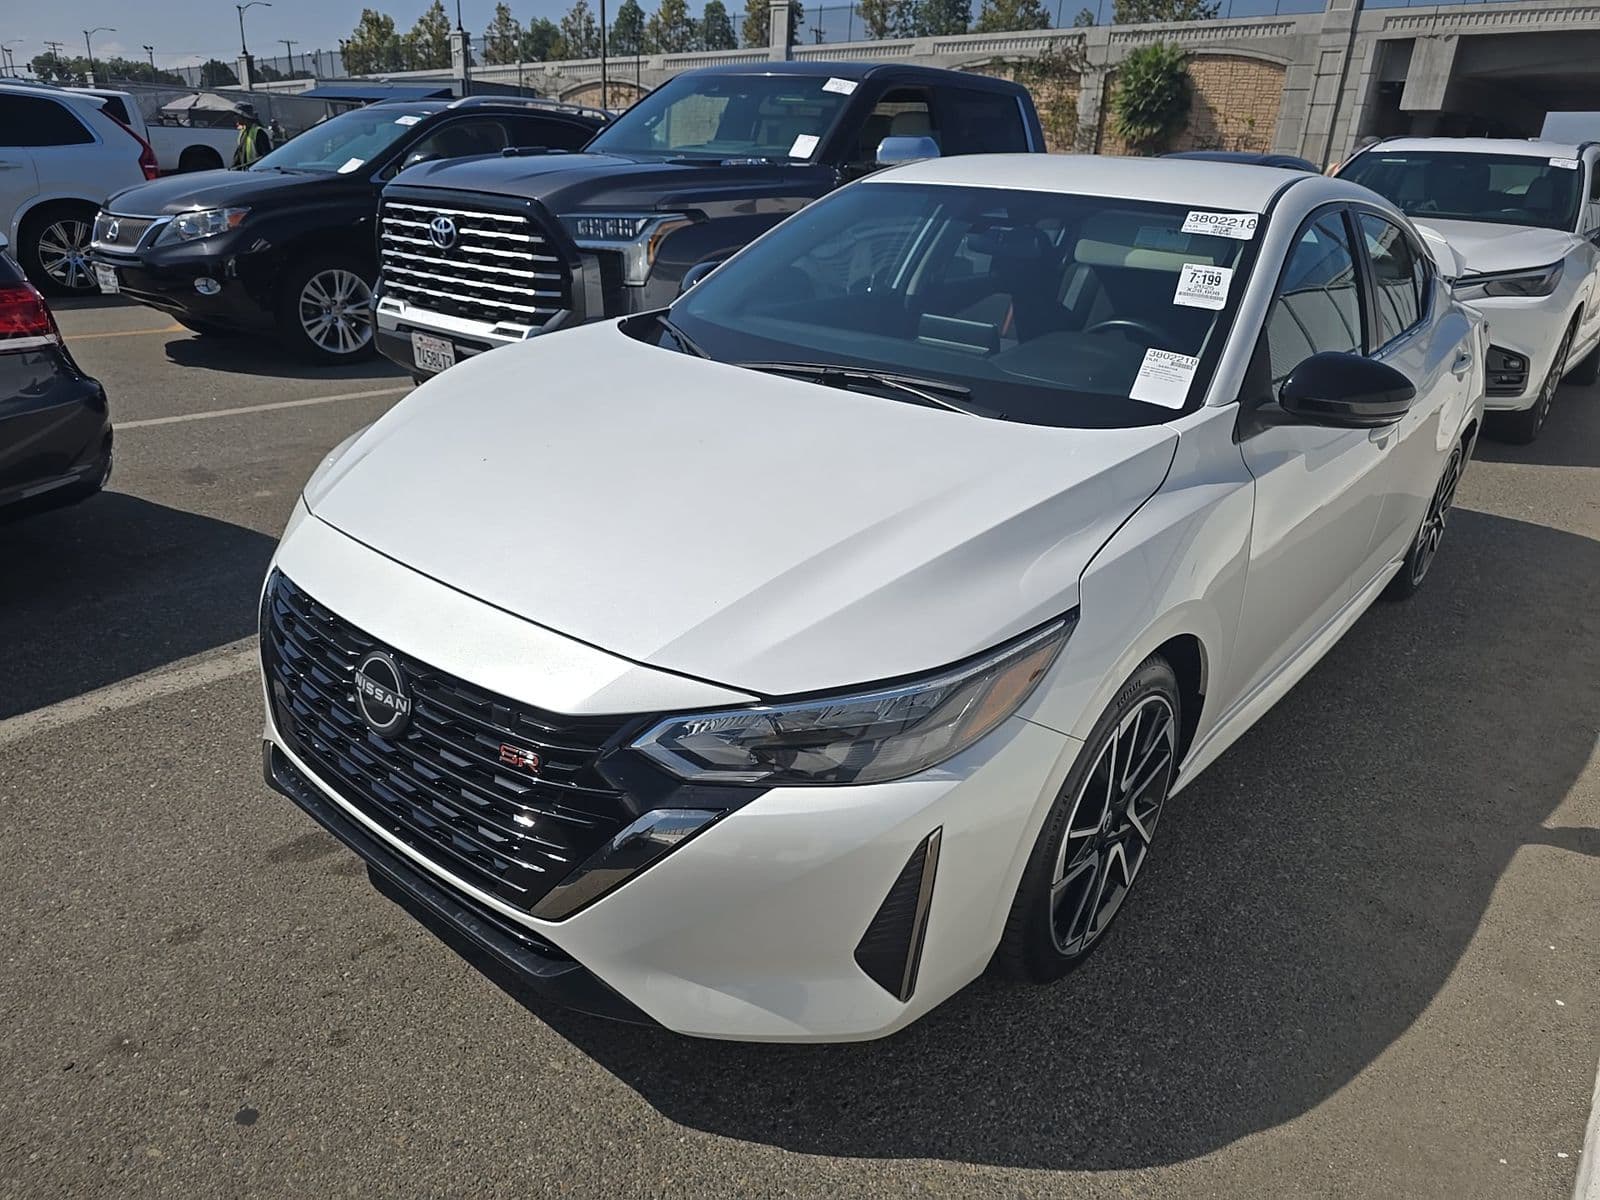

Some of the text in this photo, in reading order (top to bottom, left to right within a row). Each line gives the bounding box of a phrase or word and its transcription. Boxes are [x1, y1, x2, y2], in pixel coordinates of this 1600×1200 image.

[1189, 213, 1257, 230] 3802218
[1190, 272, 1222, 286] 7:199
[1148, 350, 1198, 366] 3802218
[355, 671, 408, 713] NISSAN
[499, 743, 539, 773] SR
